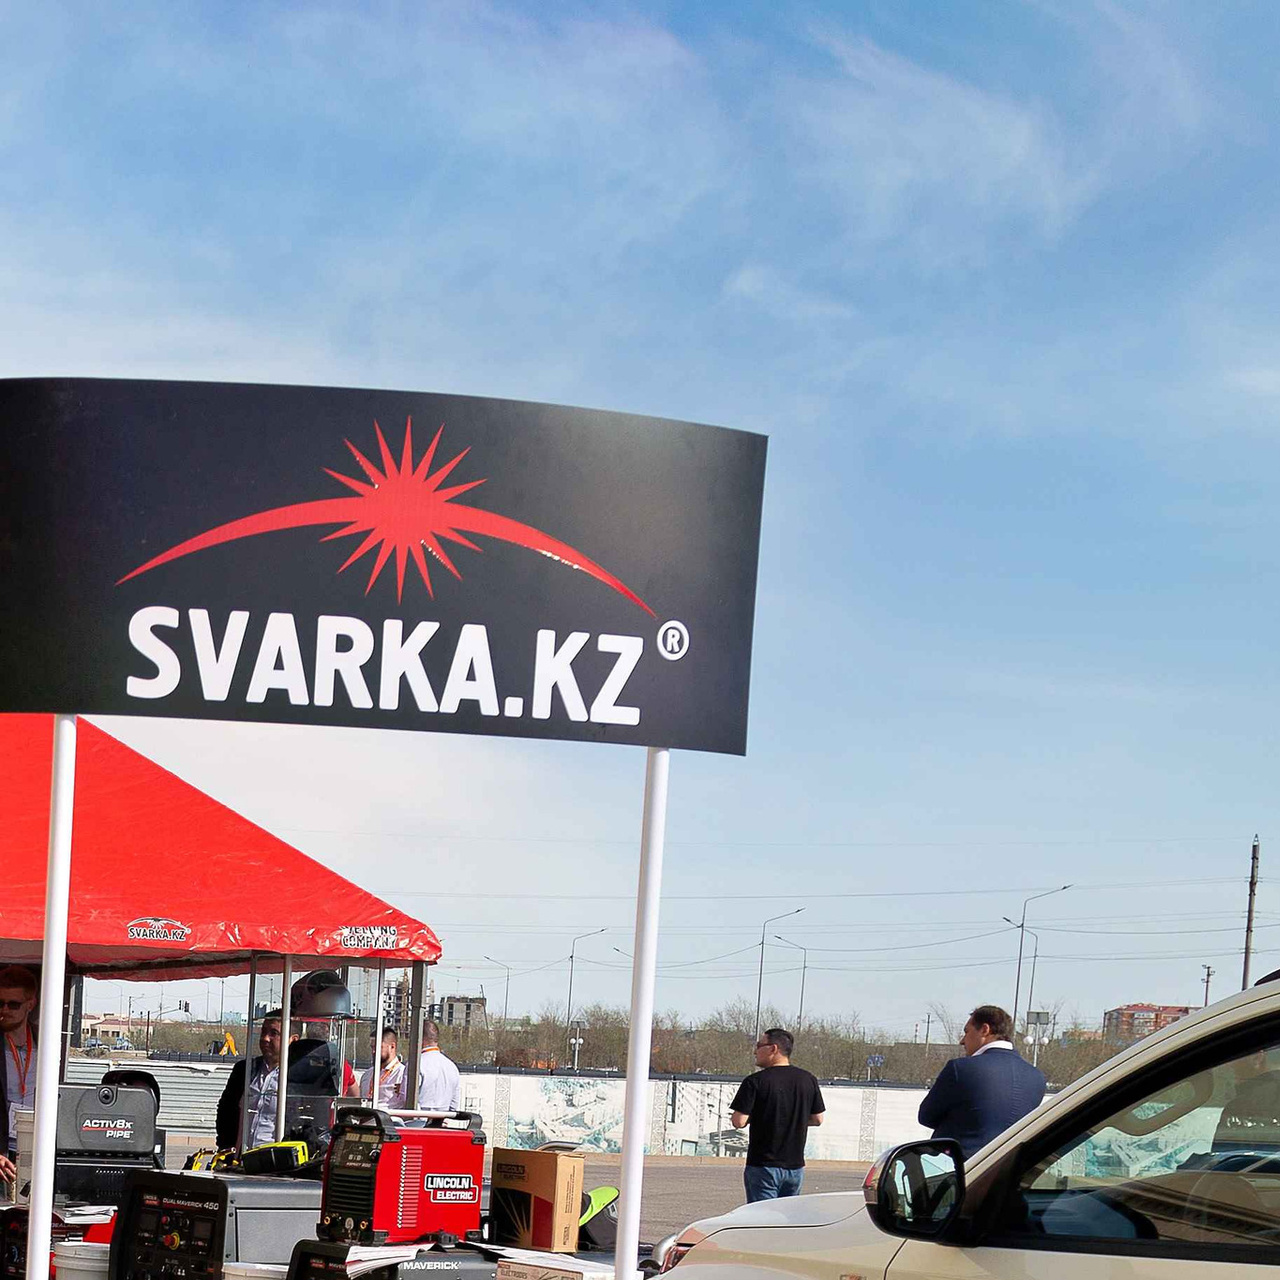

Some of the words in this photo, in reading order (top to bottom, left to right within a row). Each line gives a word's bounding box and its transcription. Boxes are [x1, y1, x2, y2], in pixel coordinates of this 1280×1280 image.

[126, 605, 644, 726] SVARKA.KZ
[128, 926, 186, 940] SVARKA.KZ
[106, 1130, 132, 1139] PIPE
[427, 1176, 470, 1189] LINCOLN
[436, 1190, 474, 1200] ELECTRIC
[176, 1199, 203, 1208] MAVERICK
[203, 1201, 220, 1211] 450
[403, 1261, 459, 1270] MAVERICK
